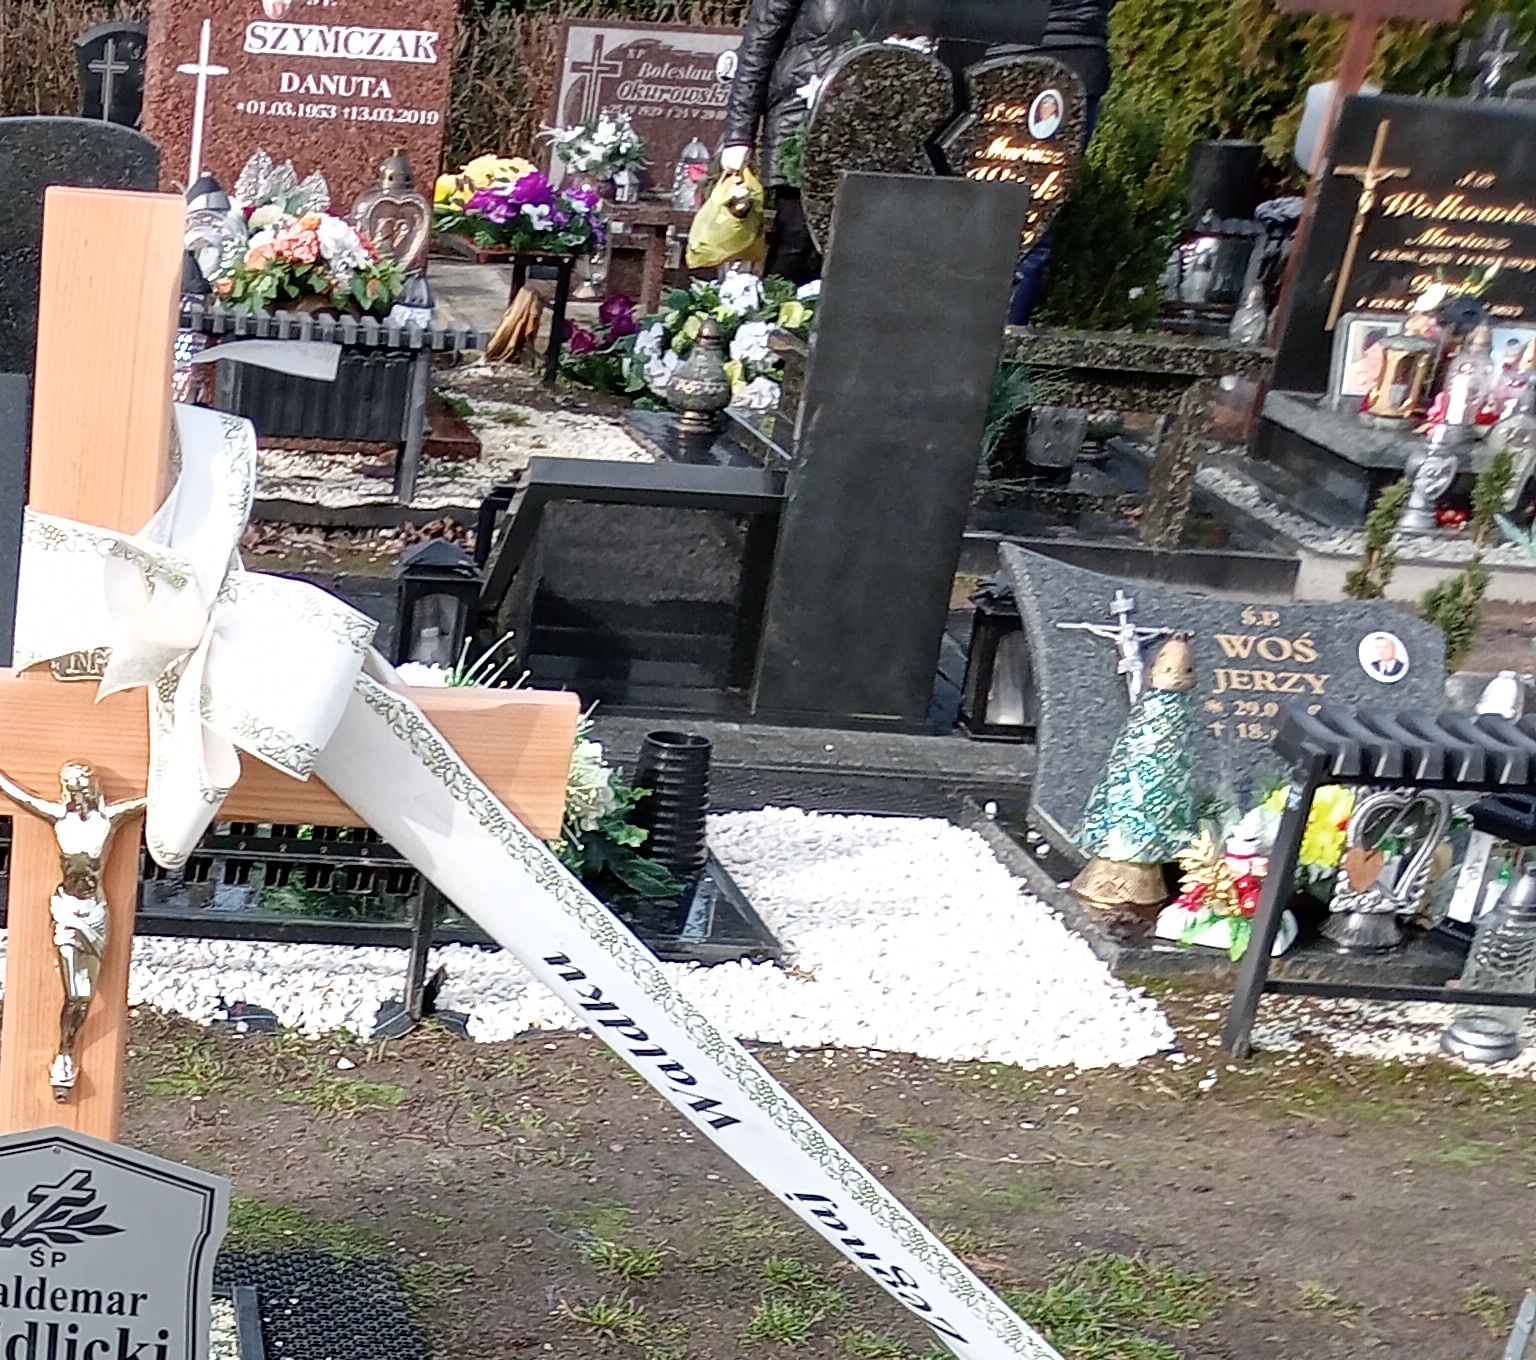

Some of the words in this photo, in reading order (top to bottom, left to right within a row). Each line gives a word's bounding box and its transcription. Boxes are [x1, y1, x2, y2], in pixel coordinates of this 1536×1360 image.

[246, 23, 438, 62] SZYMCZAK
[279, 72, 392, 99] DANUTA
[1213, 632, 1320, 663] WOŚ
[1211, 668, 1331, 695] JERZY
[542, 951, 742, 1131] Waldku
